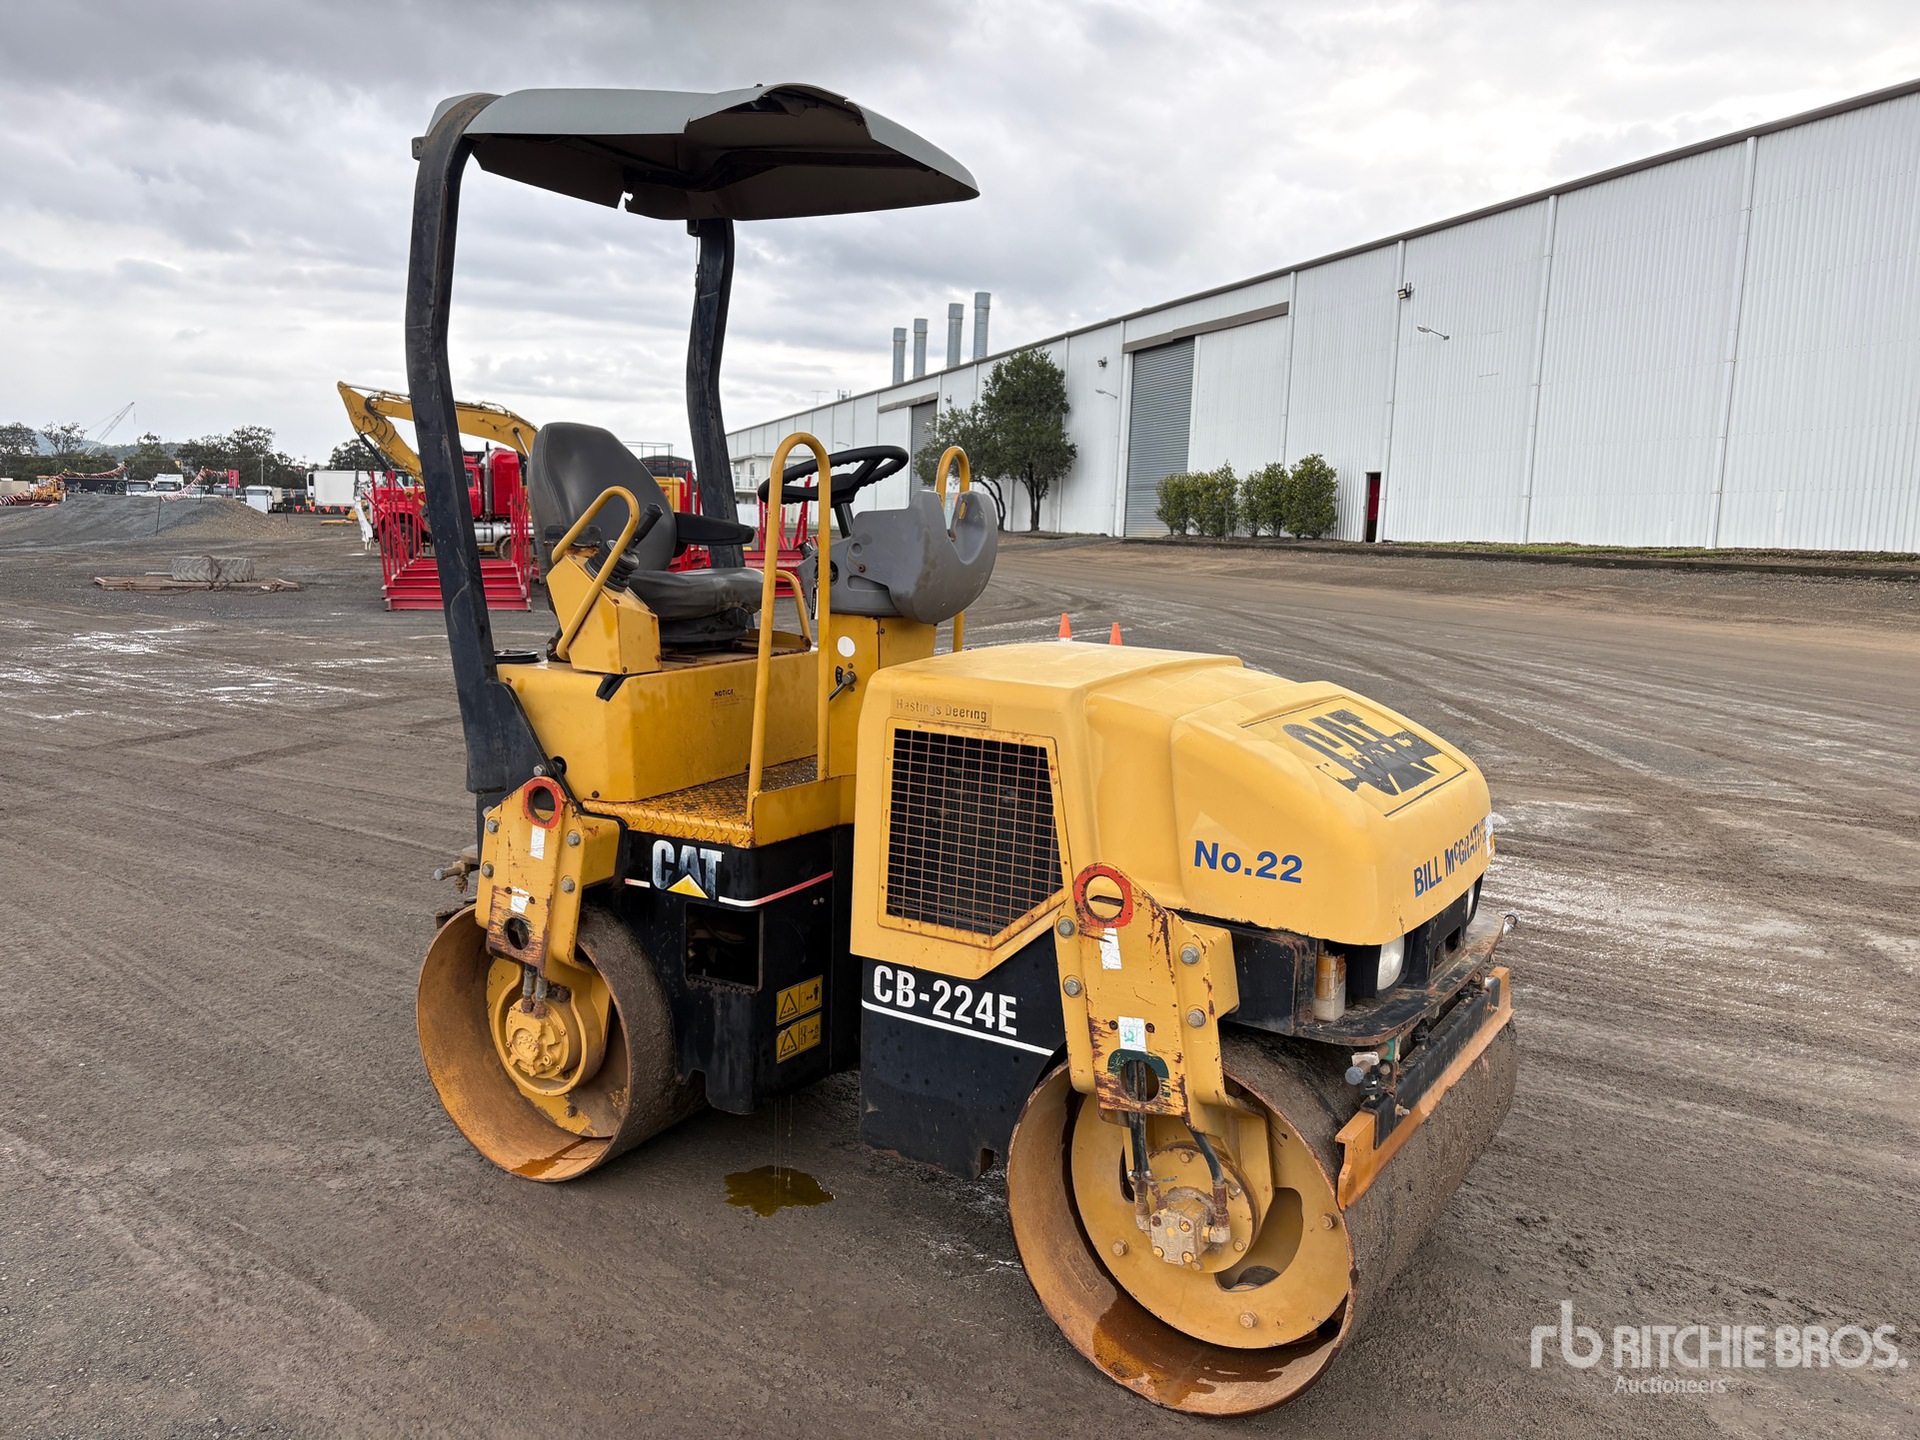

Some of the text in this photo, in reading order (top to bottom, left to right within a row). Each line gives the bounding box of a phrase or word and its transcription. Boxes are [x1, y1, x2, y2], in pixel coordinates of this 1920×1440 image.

[945, 704, 987, 723] Deering
[1282, 709, 1441, 796] CAT
[652, 839, 723, 900] CAT
[1194, 840, 1303, 884] No.22
[1414, 856, 1442, 898] BILL
[873, 965, 1017, 1036] CB-224E
